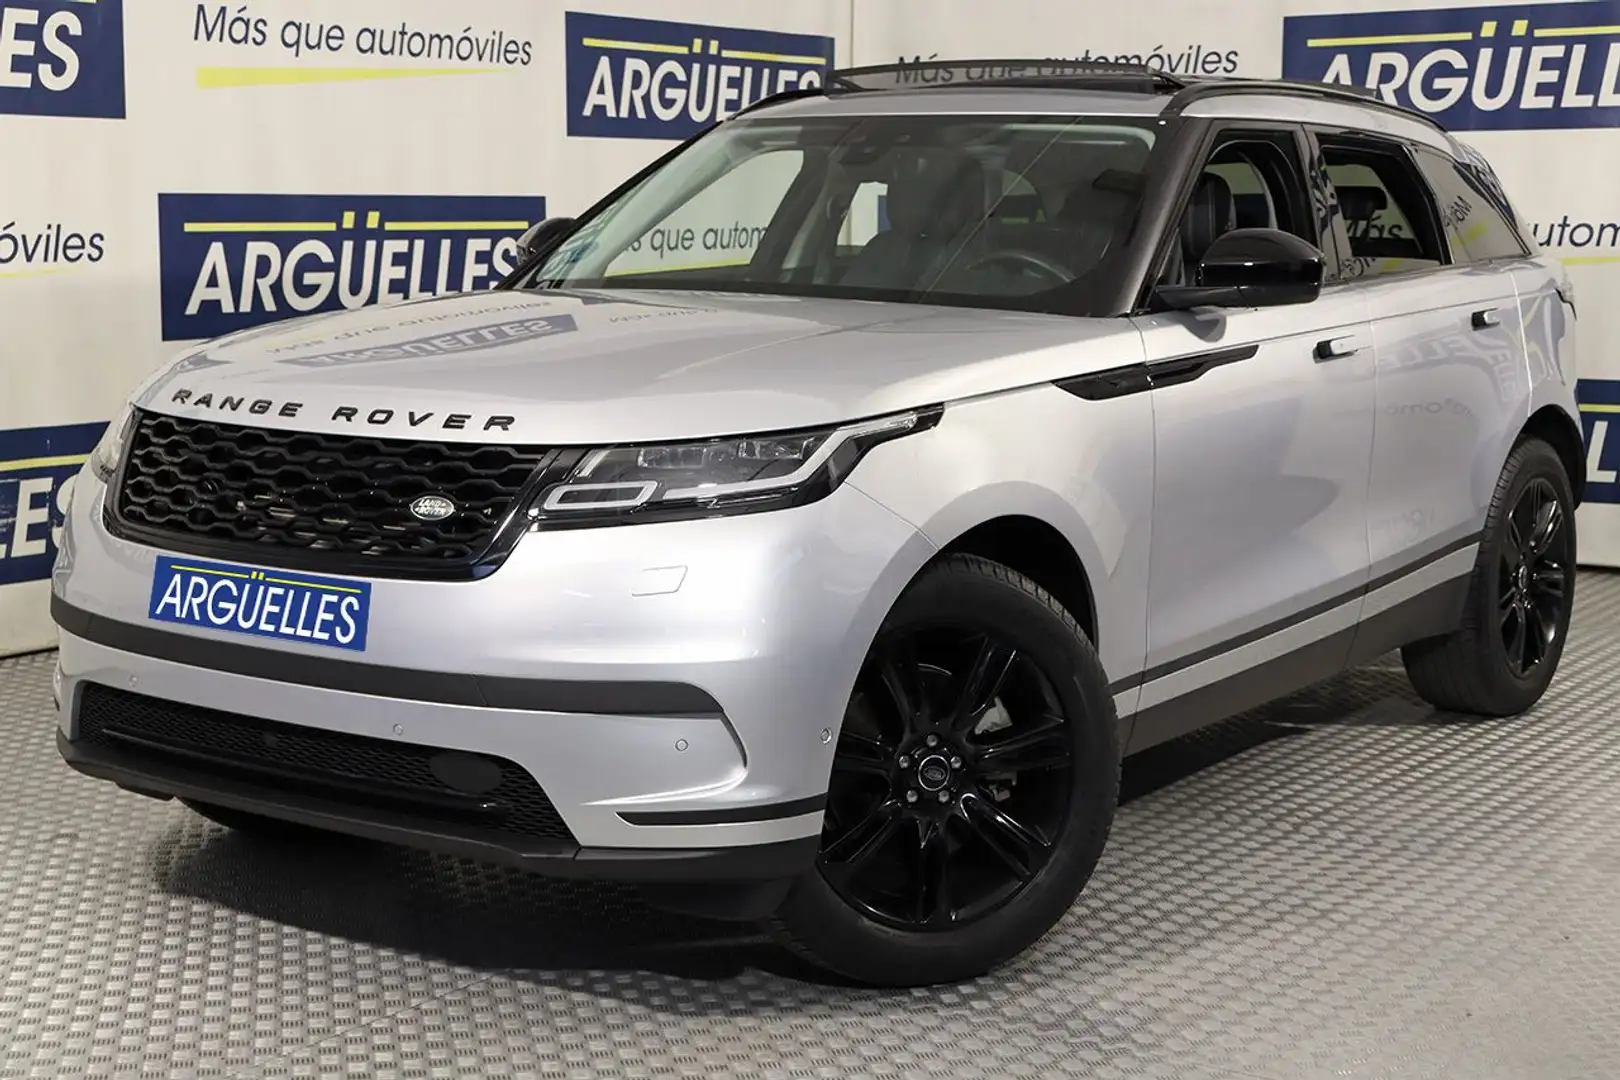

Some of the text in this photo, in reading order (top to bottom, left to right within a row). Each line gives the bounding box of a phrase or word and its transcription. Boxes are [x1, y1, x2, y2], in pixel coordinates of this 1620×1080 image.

[193, 4, 533, 66] Más que automóviles
[650, 228, 695, 259] que
[1528, 215, 1620, 248] utom
[171, 388, 516, 432] RANGE ROVER
[418, 498, 442, 507] LAND
[155, 571, 360, 644] ARGÜELLES
